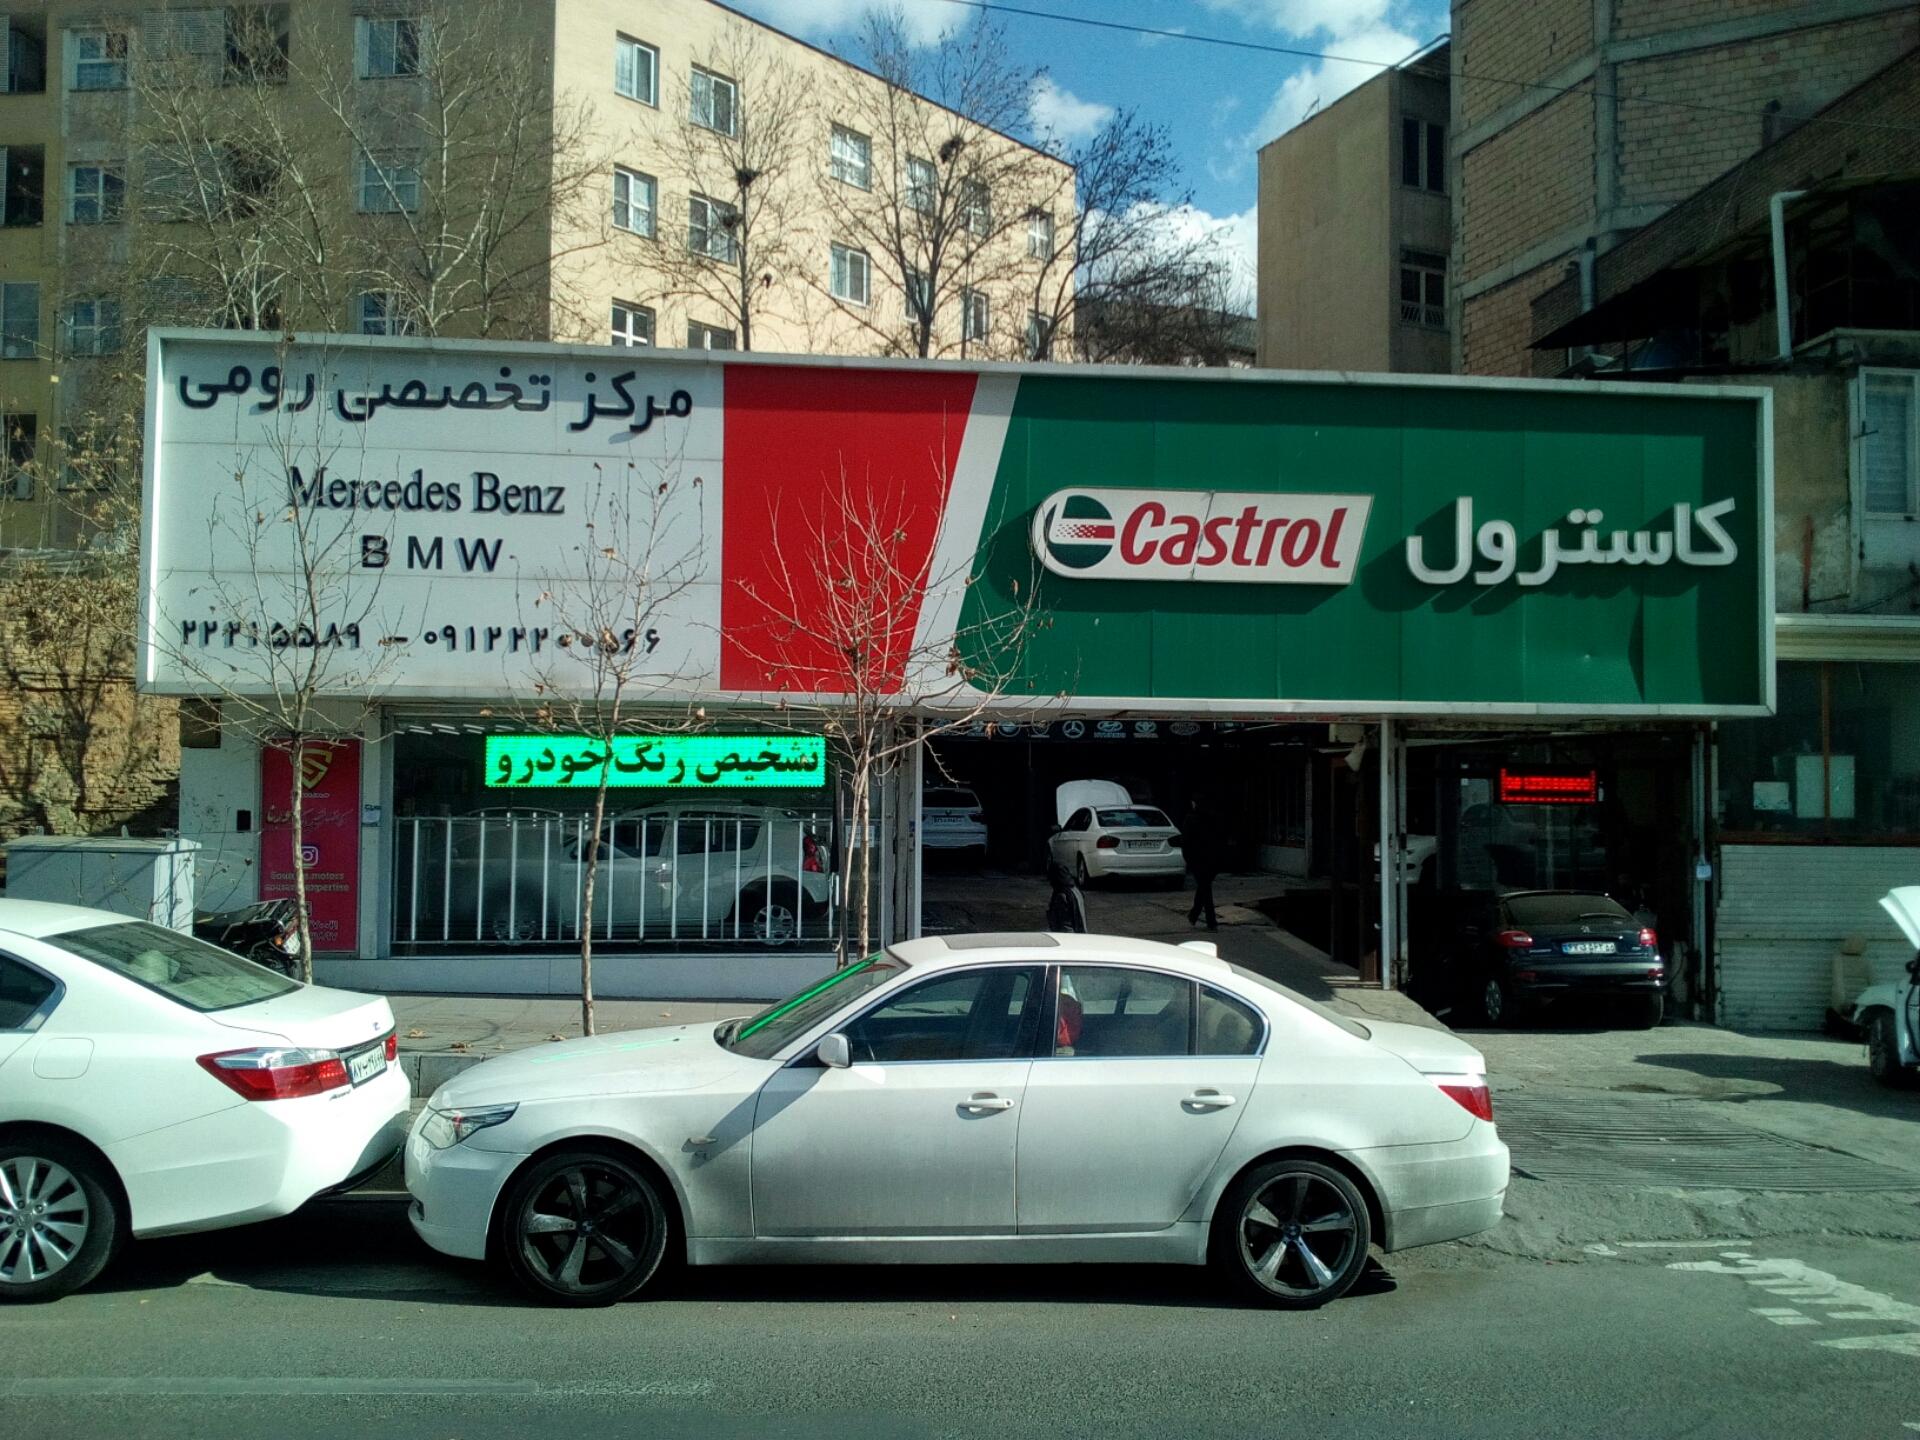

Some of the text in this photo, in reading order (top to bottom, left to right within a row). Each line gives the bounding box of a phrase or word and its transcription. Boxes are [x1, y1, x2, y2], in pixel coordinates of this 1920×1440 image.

[180, 364, 693, 432] مرکز تخصصی رومی
[288, 465, 566, 515] Mercedes Benz
[1118, 500, 1344, 569] Castrol
[1406, 496, 1738, 586] کاسترول
[495, 738, 820, 784] تشخیص رنگ خودرو
